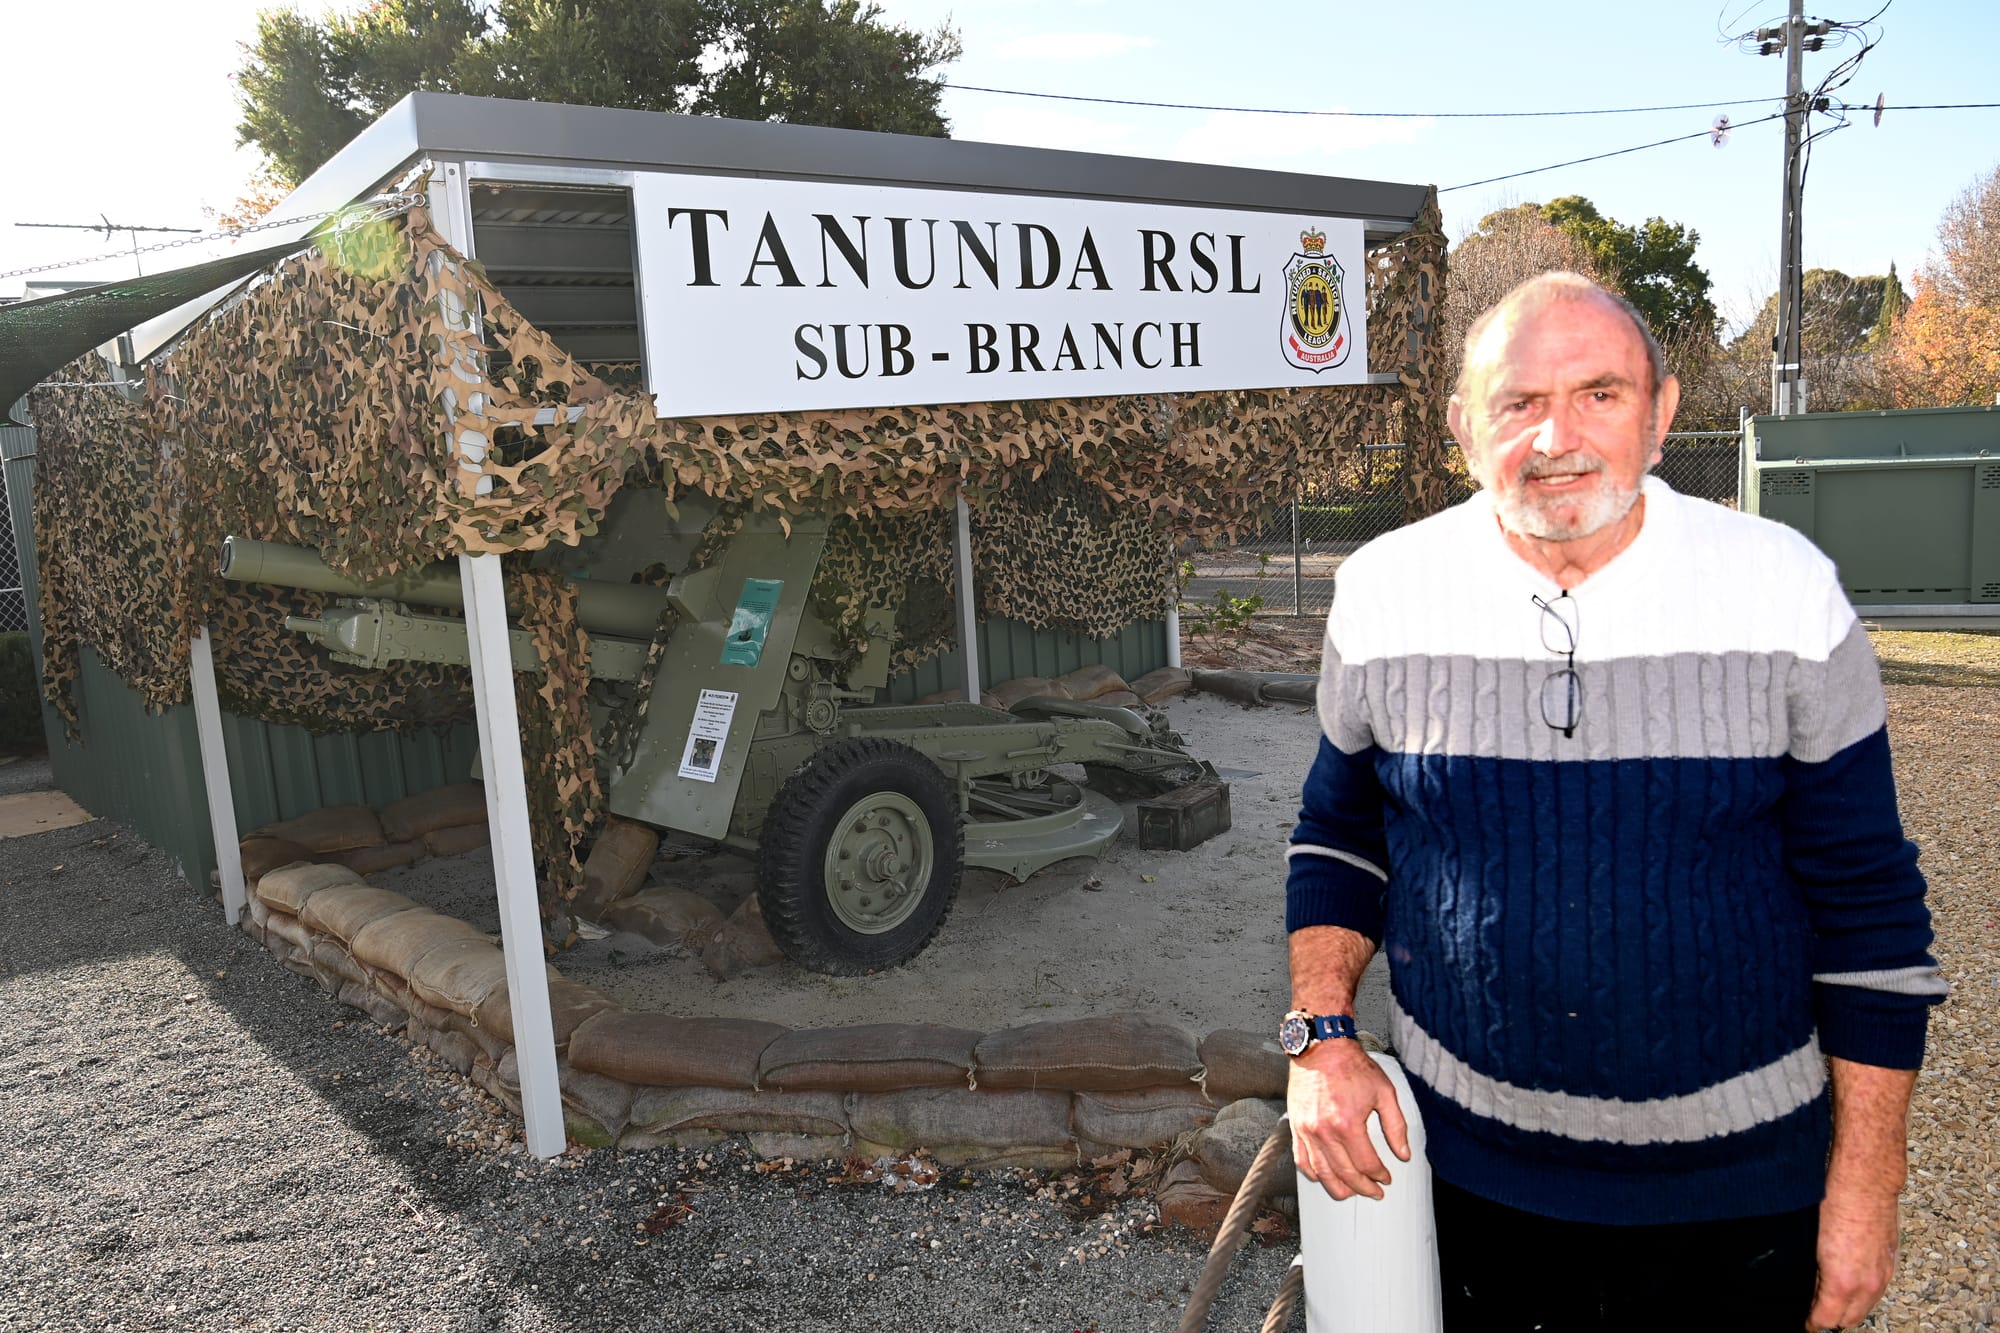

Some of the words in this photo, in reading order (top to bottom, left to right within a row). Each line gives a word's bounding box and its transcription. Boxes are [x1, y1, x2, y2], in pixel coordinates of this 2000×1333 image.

[667, 207, 1114, 292] TANUNDA
[1137, 229, 1262, 295] RSL
[1291, 267, 1311, 315] RETURNED
[1303, 332, 1331, 345] LEAGUE
[1301, 351, 1336, 363] AUSTRALIA
